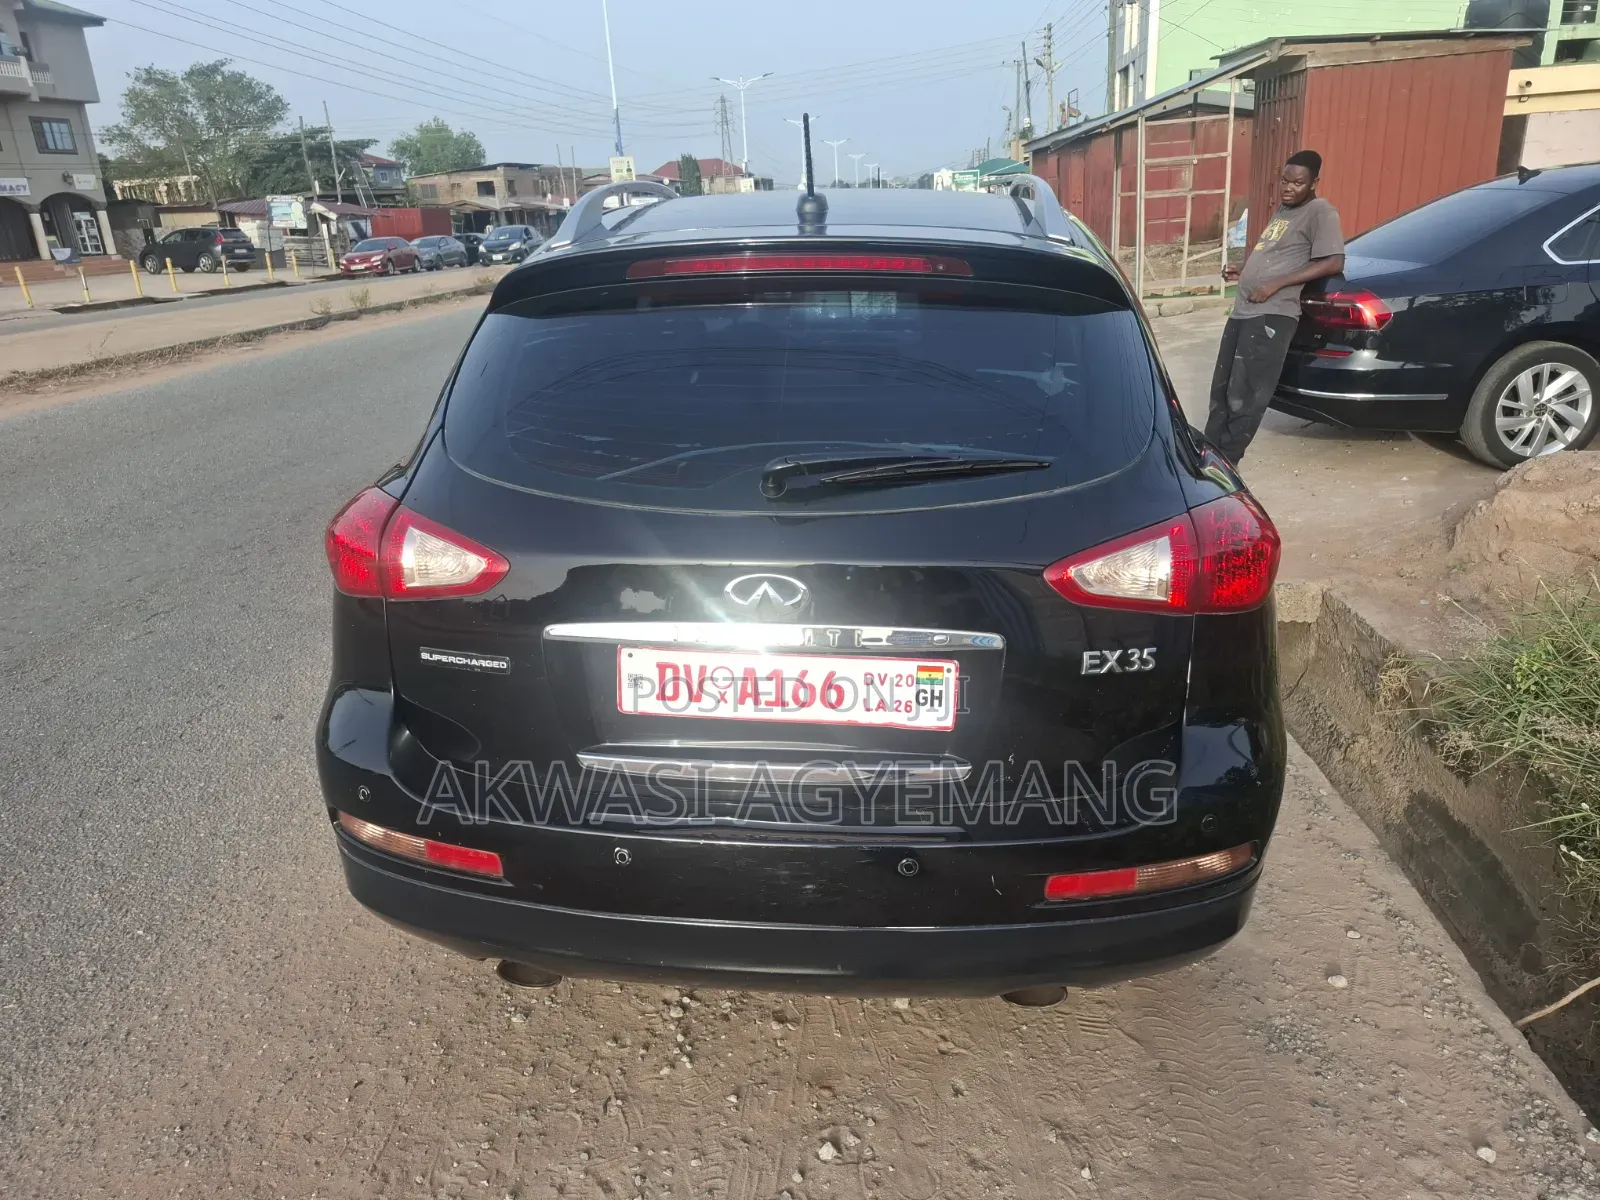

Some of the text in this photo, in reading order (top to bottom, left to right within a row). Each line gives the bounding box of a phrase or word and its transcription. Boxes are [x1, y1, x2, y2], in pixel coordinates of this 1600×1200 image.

[421, 652, 507, 669] SUPERCHARGED
[656, 661, 707, 703] DV
[738, 667, 845, 709] A166
[915, 689, 943, 708] GH
